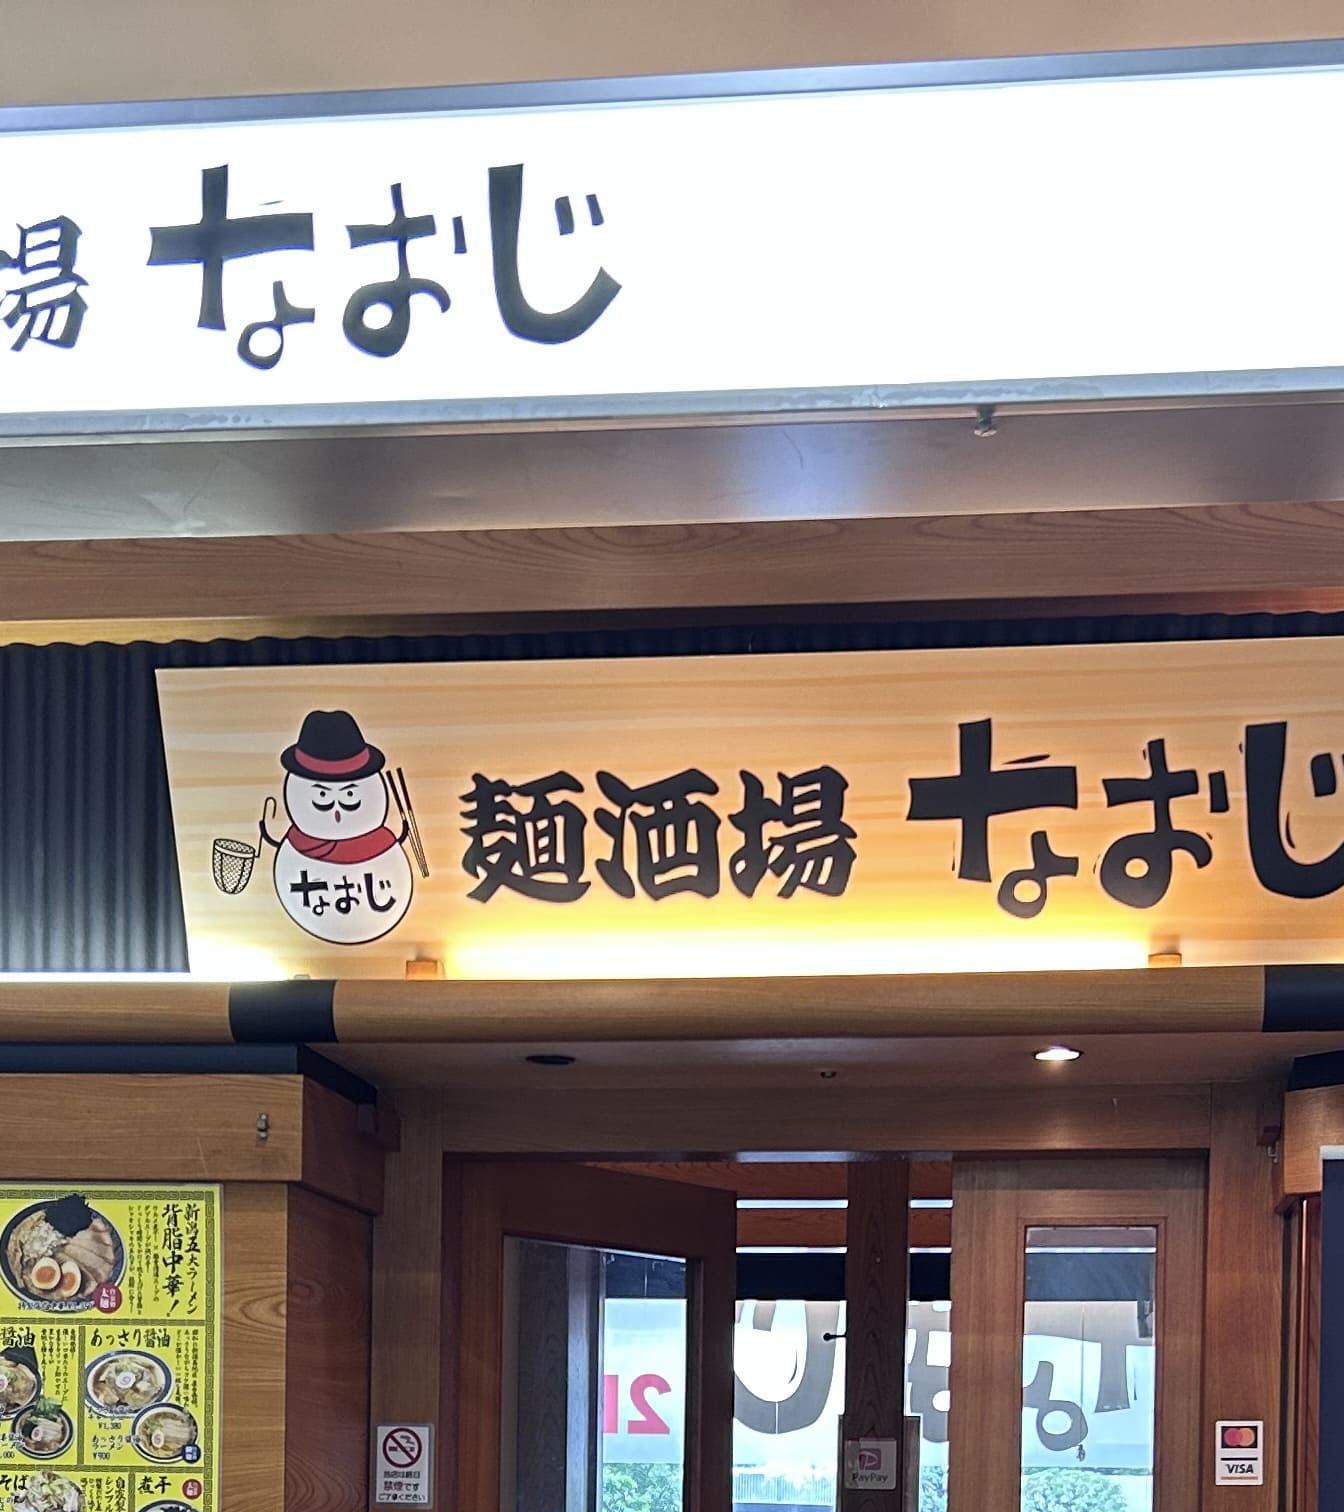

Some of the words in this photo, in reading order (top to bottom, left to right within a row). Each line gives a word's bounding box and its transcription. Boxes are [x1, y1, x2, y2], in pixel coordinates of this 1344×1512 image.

[146, 162, 623, 371] なおじ
[459, 765, 858, 904] 麺酒場
[289, 869, 397, 917] なおじ
[184, 1202, 201, 1315] 新潟五大ラーメン
[90, 1328, 171, 1348] あっさり醤油
[852, 1472, 889, 1483] PayPay
[1224, 1463, 1254, 1474] VISA
[137, 1475, 172, 1494] 煮干
[383, 1481, 420, 1491] 禁煙です
